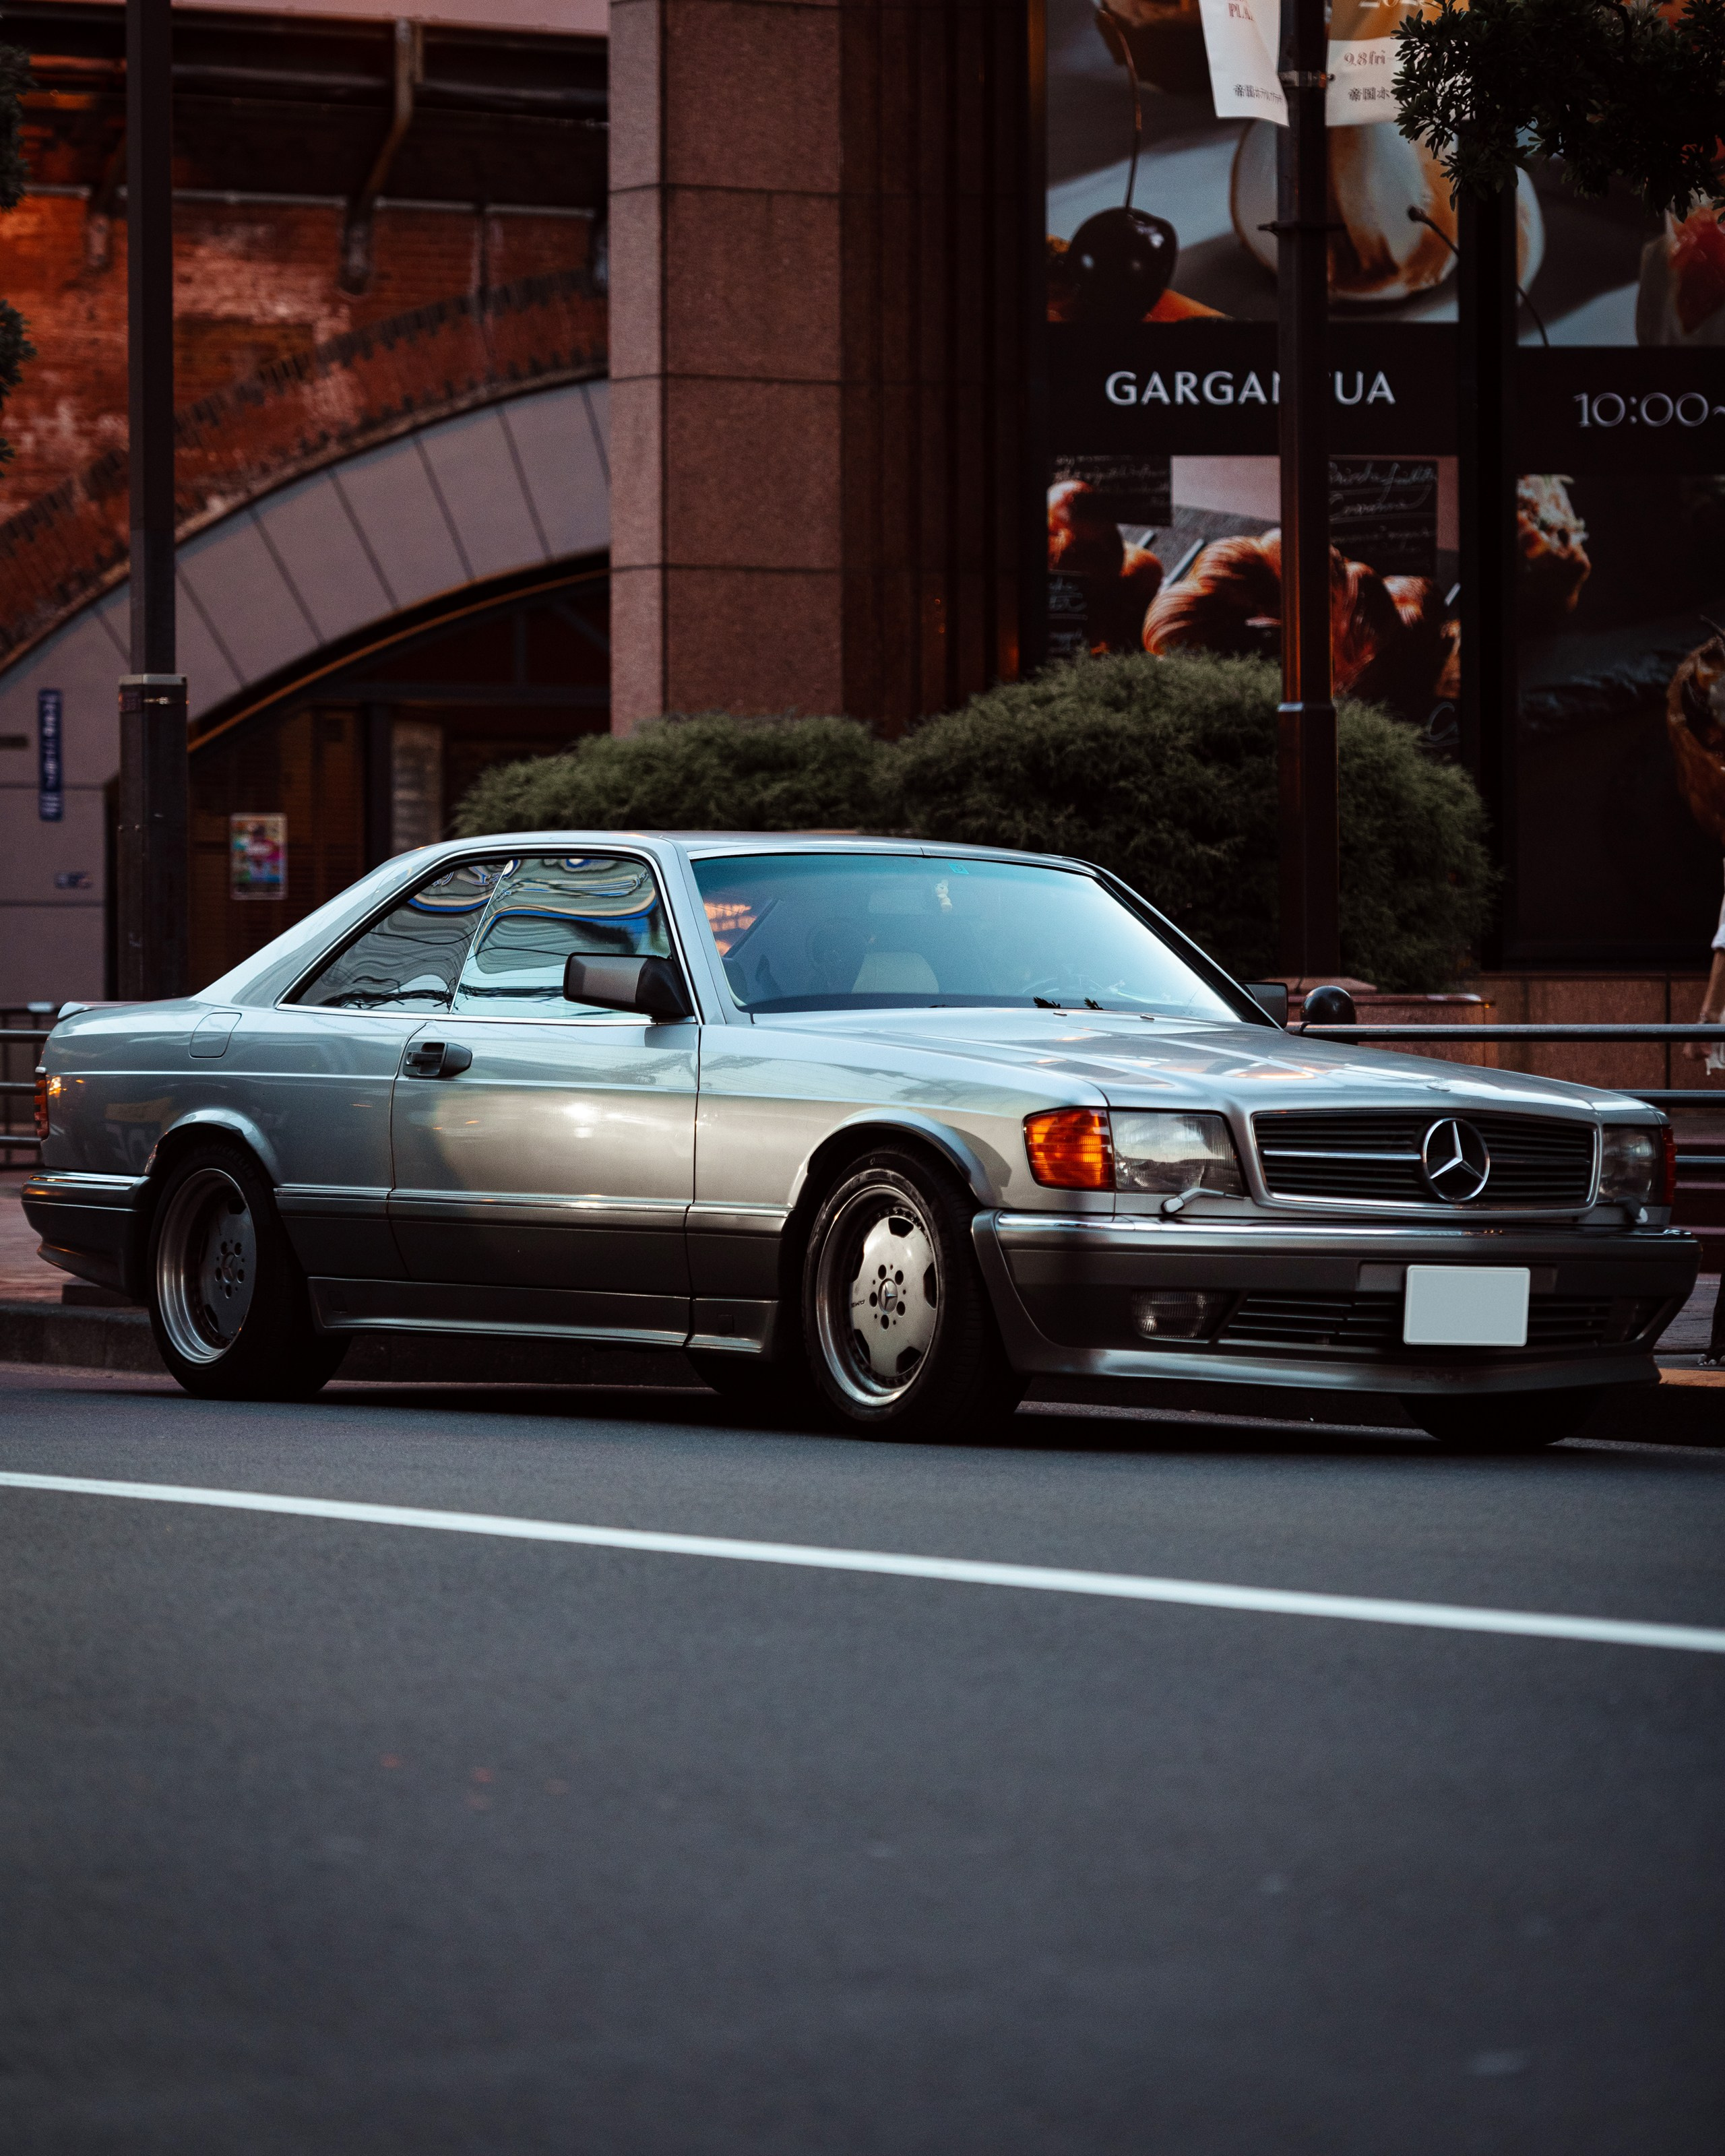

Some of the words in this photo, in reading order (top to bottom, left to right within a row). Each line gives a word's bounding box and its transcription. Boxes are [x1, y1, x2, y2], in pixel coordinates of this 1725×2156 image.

[1348, 86, 1393, 102] 帝国ホ
[1105, 371, 1395, 405] GARGAUA
